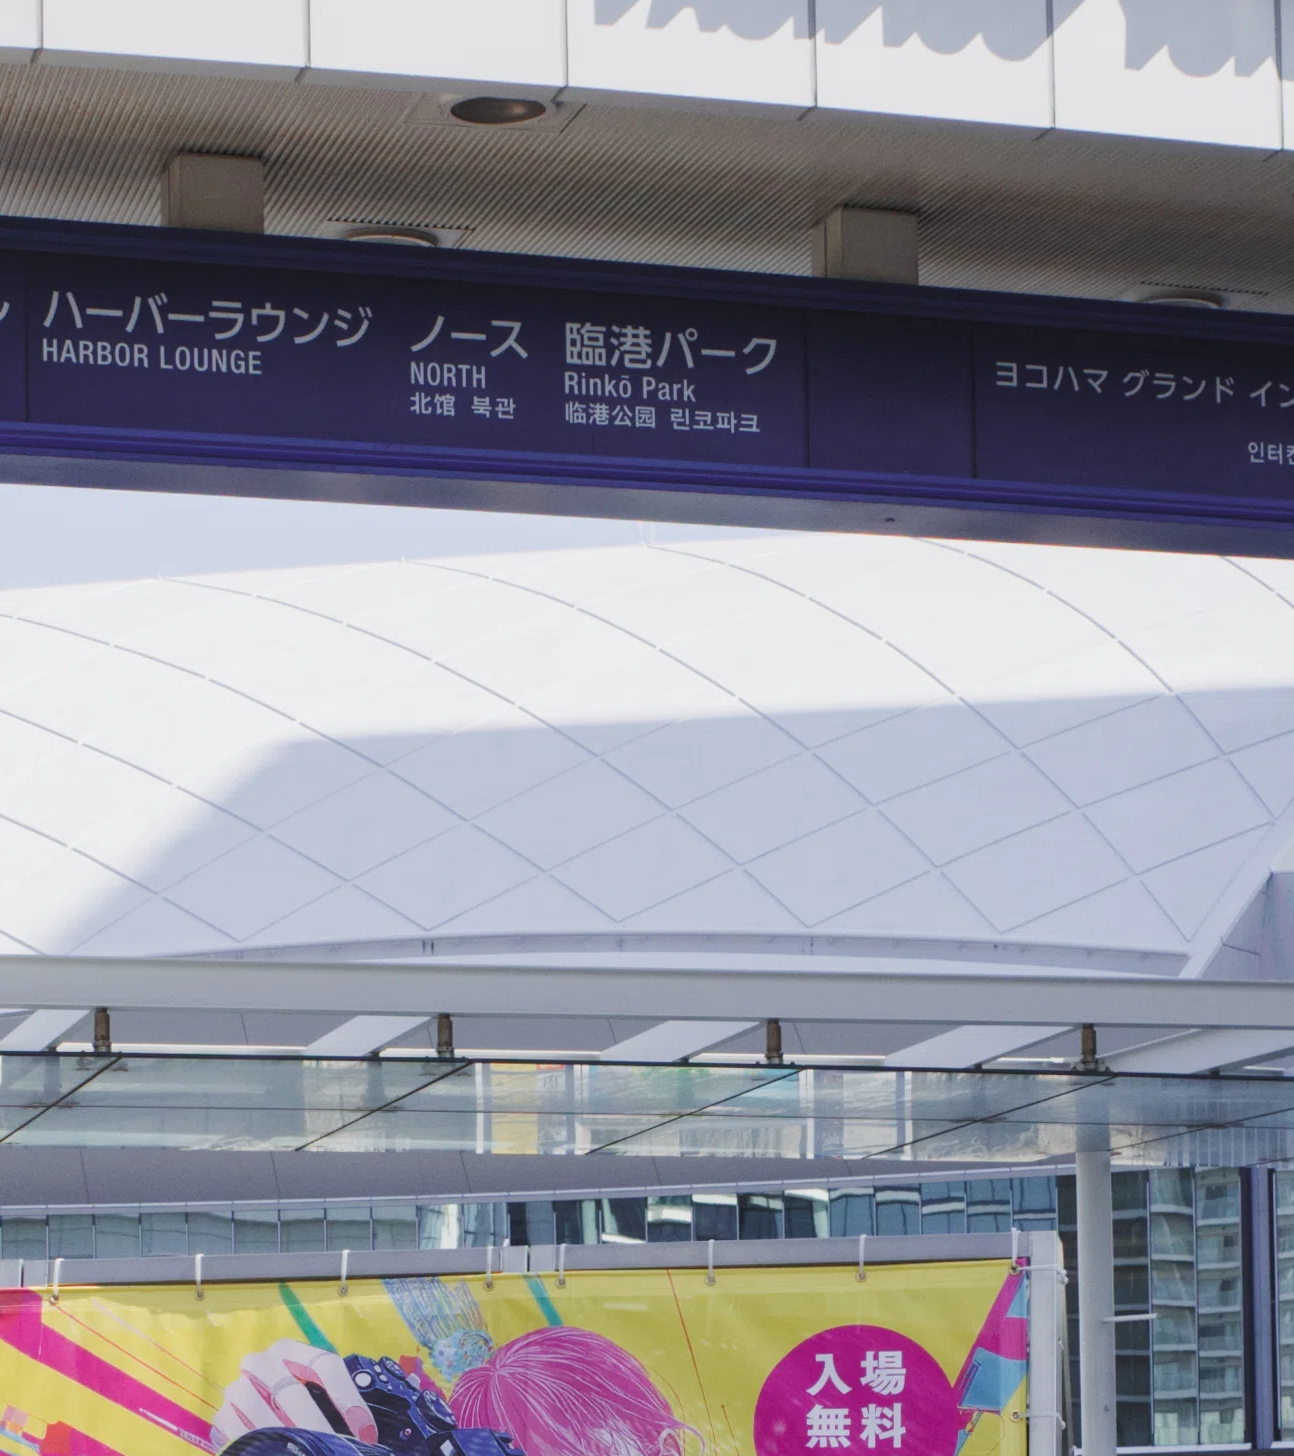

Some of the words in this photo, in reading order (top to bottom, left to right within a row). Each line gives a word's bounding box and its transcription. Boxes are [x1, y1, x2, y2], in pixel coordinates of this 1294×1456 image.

[43, 291, 372, 347] ハーバーラウンジ
[410, 315, 529, 360] ノース
[43, 339, 148, 368] HARBOR
[160, 346, 262, 375] LOUNGE
[565, 321, 778, 375] 臨港パーク
[410, 362, 486, 389] NORTH
[564, 371, 632, 398] Rinkō
[642, 376, 697, 403] Park
[996, 361, 1108, 395] ヨコハマ
[1123, 368, 1234, 404] グランド
[410, 392, 455, 417] 北馆
[471, 396, 516, 420] 북관
[565, 400, 656, 428] 临港公园
[670, 407, 760, 434] 린코파크
[805, 1350, 906, 1395] 入場
[805, 1403, 906, 1448] 無料
